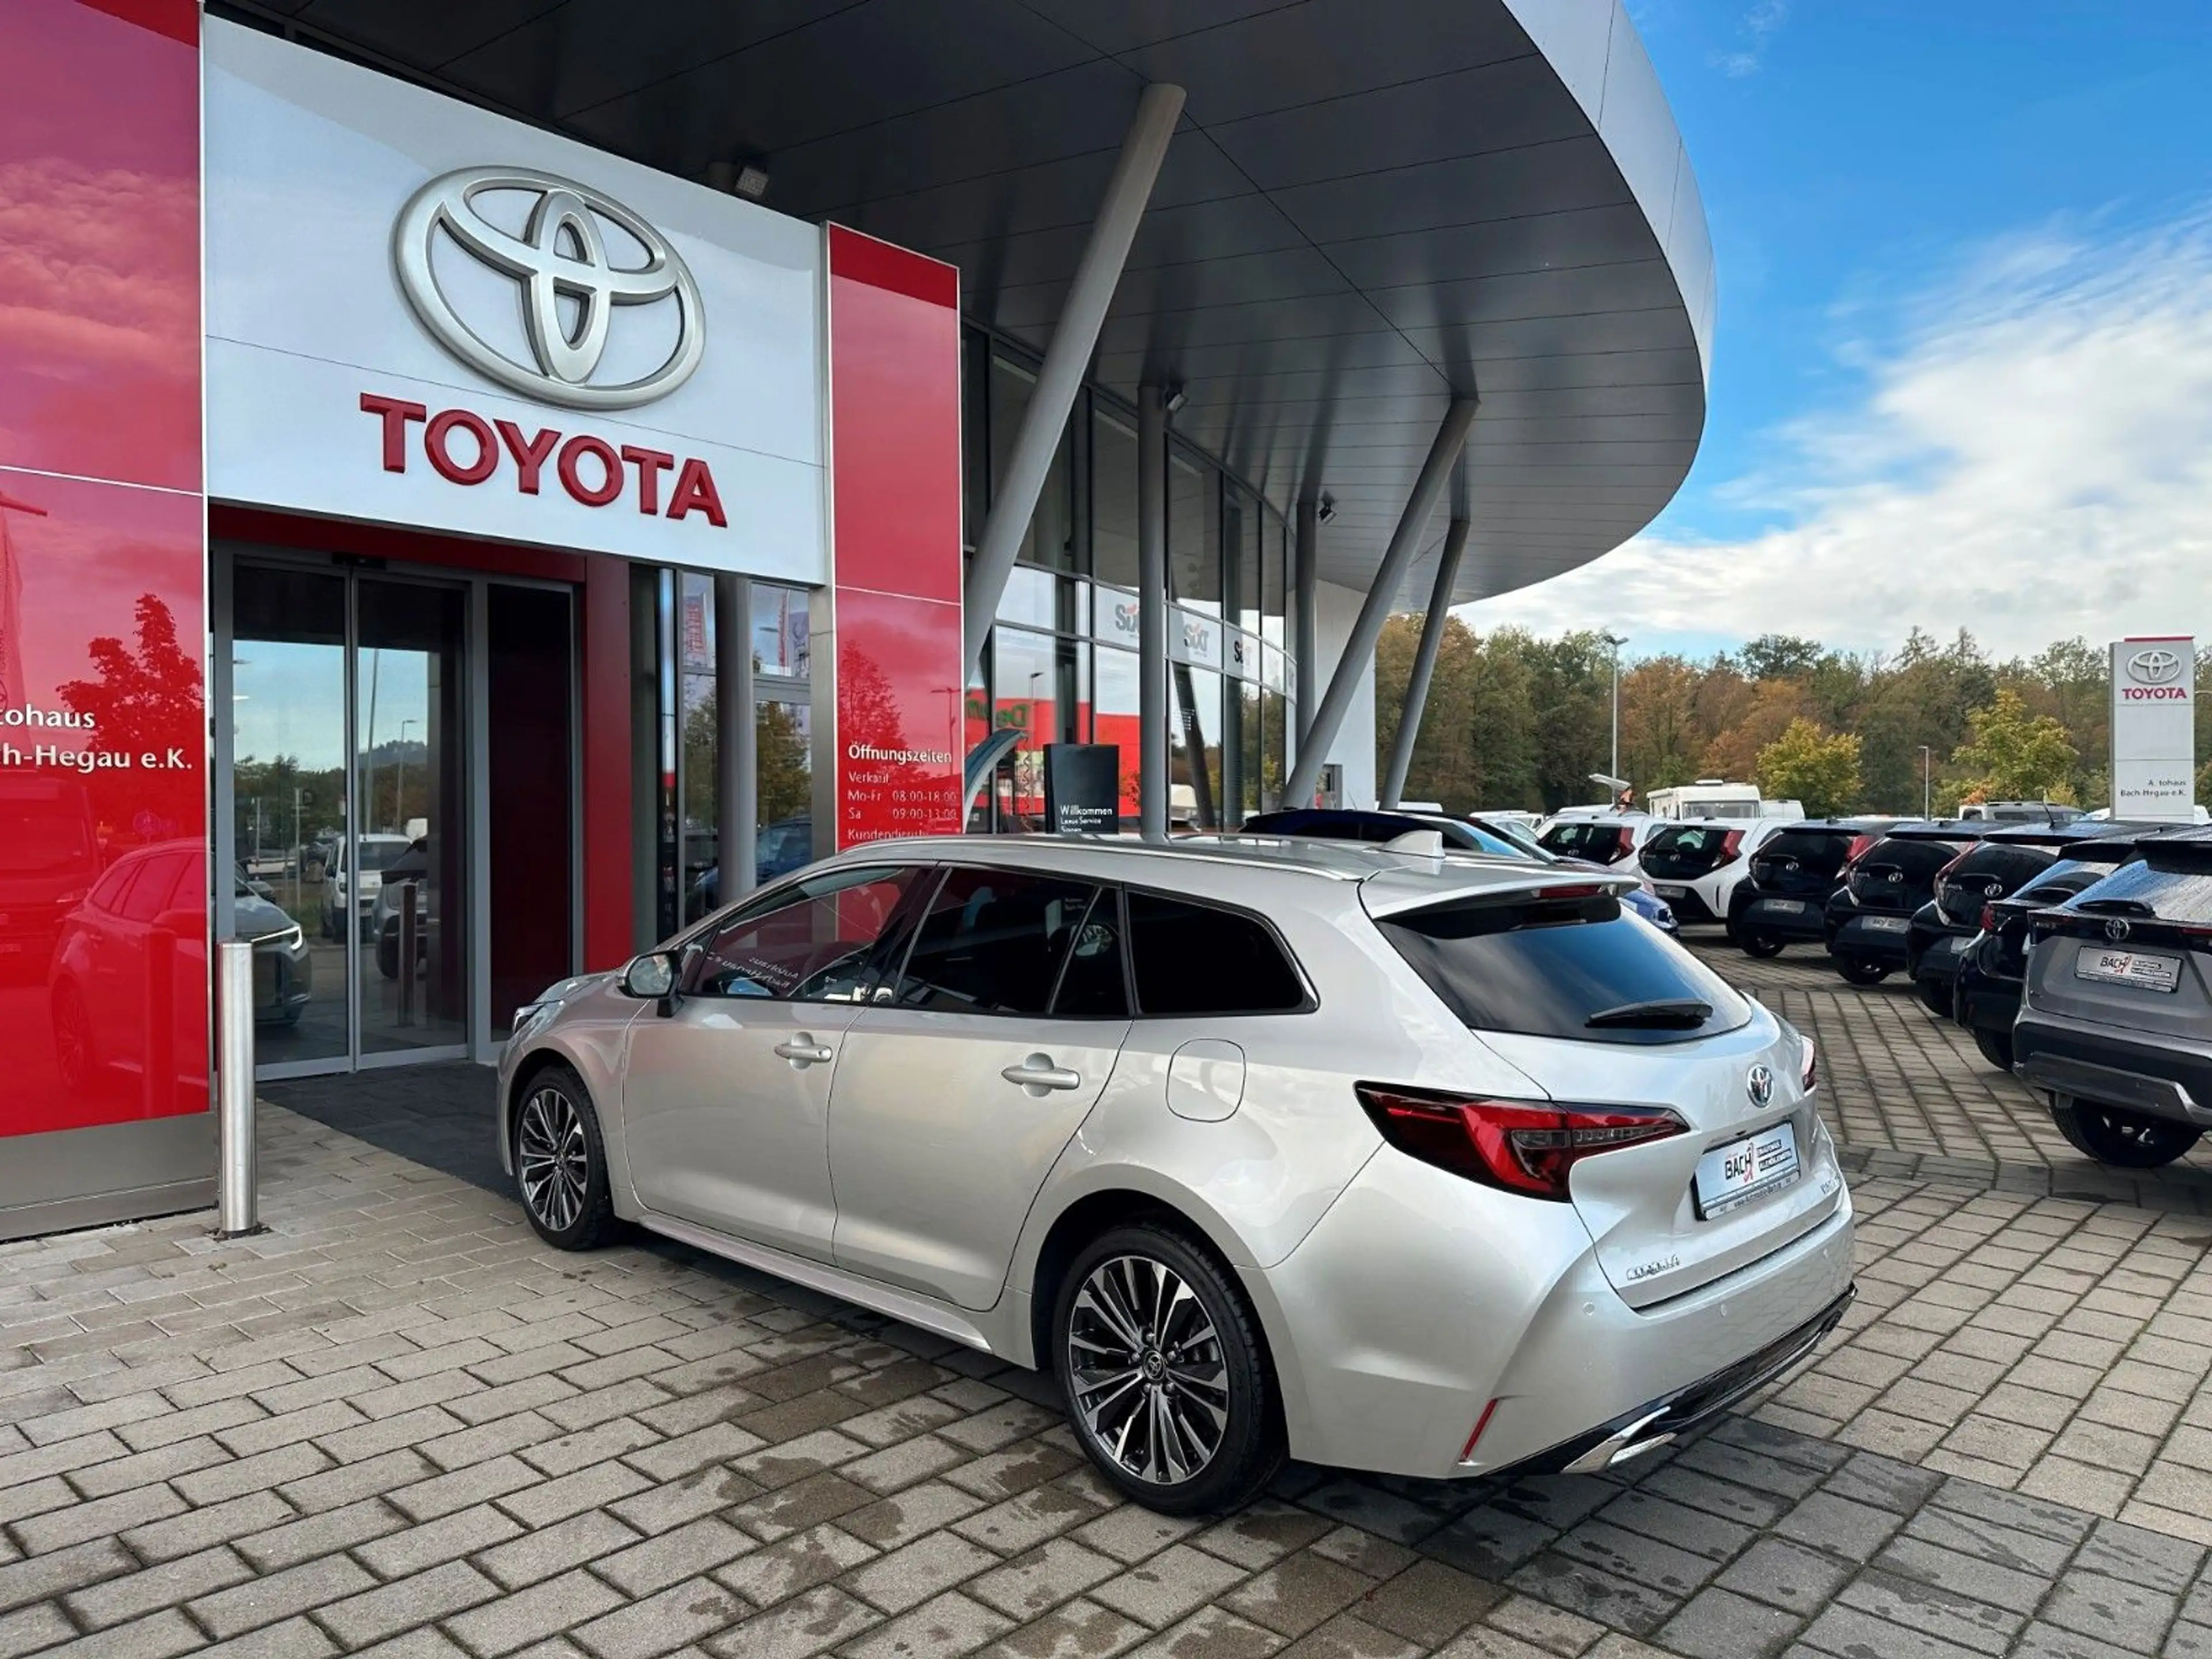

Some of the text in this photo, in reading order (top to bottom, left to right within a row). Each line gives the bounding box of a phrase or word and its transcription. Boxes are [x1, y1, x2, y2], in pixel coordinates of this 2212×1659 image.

[360, 393, 727, 528] TOYOTA
[2122, 687, 2187, 699] TOYOTA
[2, 743, 192, 773] h-Hegau e.K.
[849, 741, 952, 766] Öffnungszeiten
[848, 806, 861, 819] Sa
[1725, 1152, 1752, 1180] BACH
